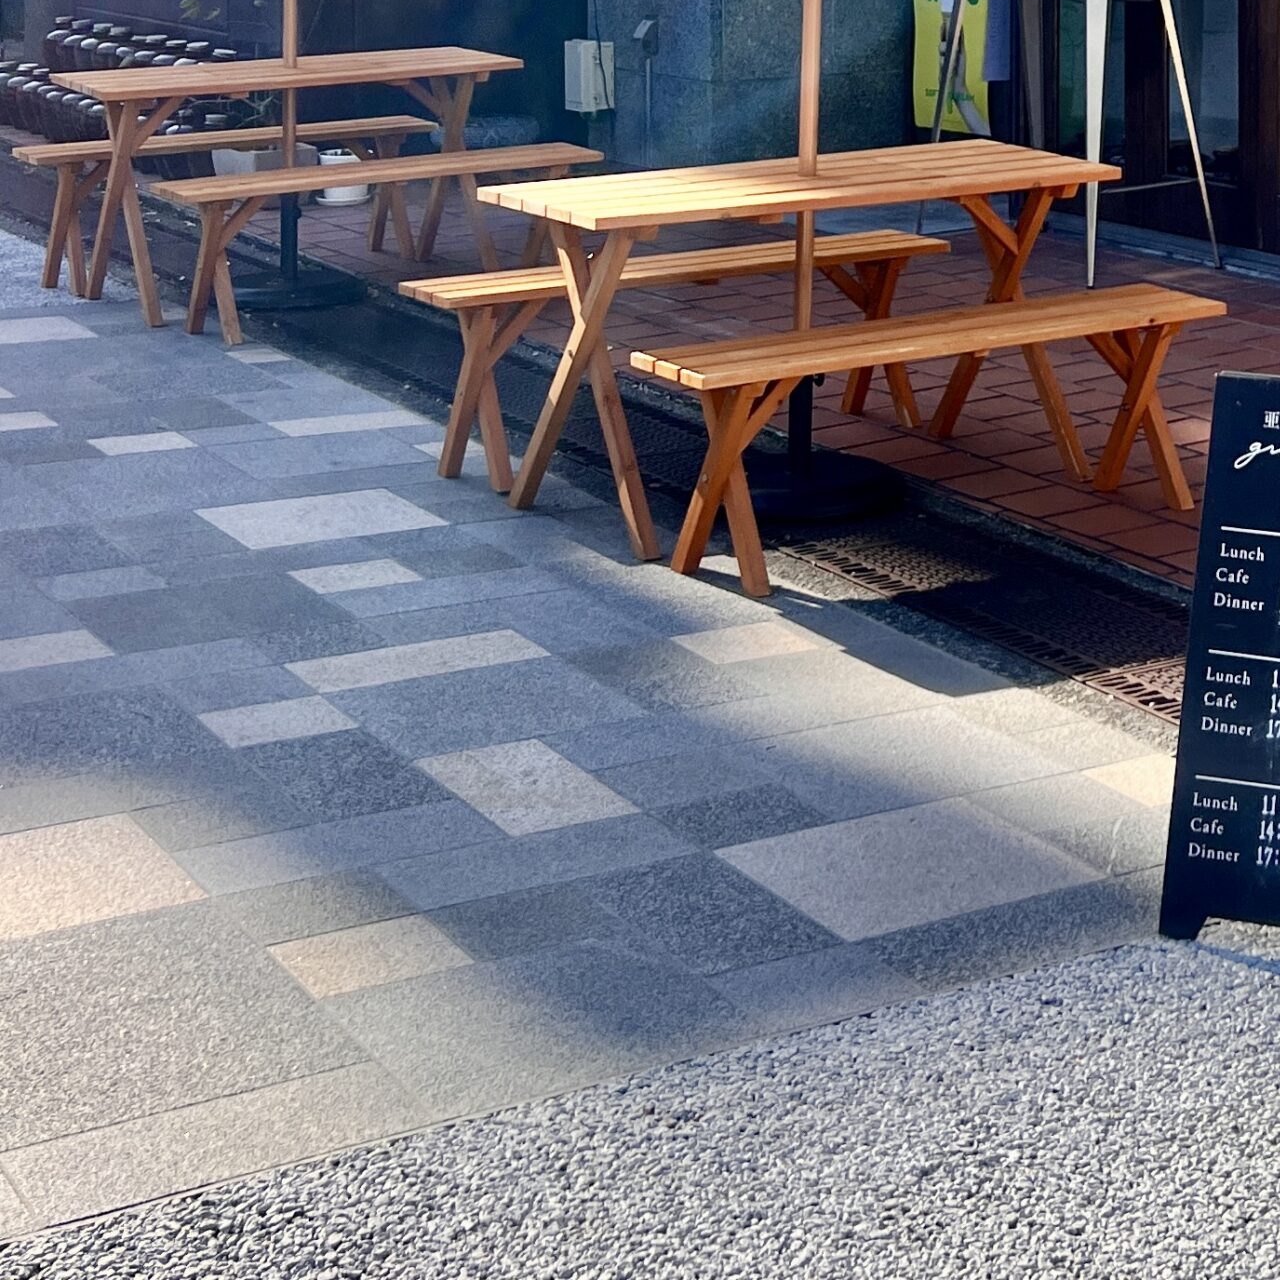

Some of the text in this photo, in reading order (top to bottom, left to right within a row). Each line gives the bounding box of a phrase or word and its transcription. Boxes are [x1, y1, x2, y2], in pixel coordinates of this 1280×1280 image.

[1220, 542, 1265, 562] Lunch
[1215, 567, 1250, 585] Cafe
[1213, 592, 1265, 612] Dinner
[1206, 666, 1251, 687] Lunch
[1203, 691, 1238, 710] Cafe
[1201, 716, 1253, 737] Dinner
[1193, 791, 1238, 812] Lunch
[1190, 817, 1225, 836] Cafe
[1188, 842, 1240, 863] Dinner
